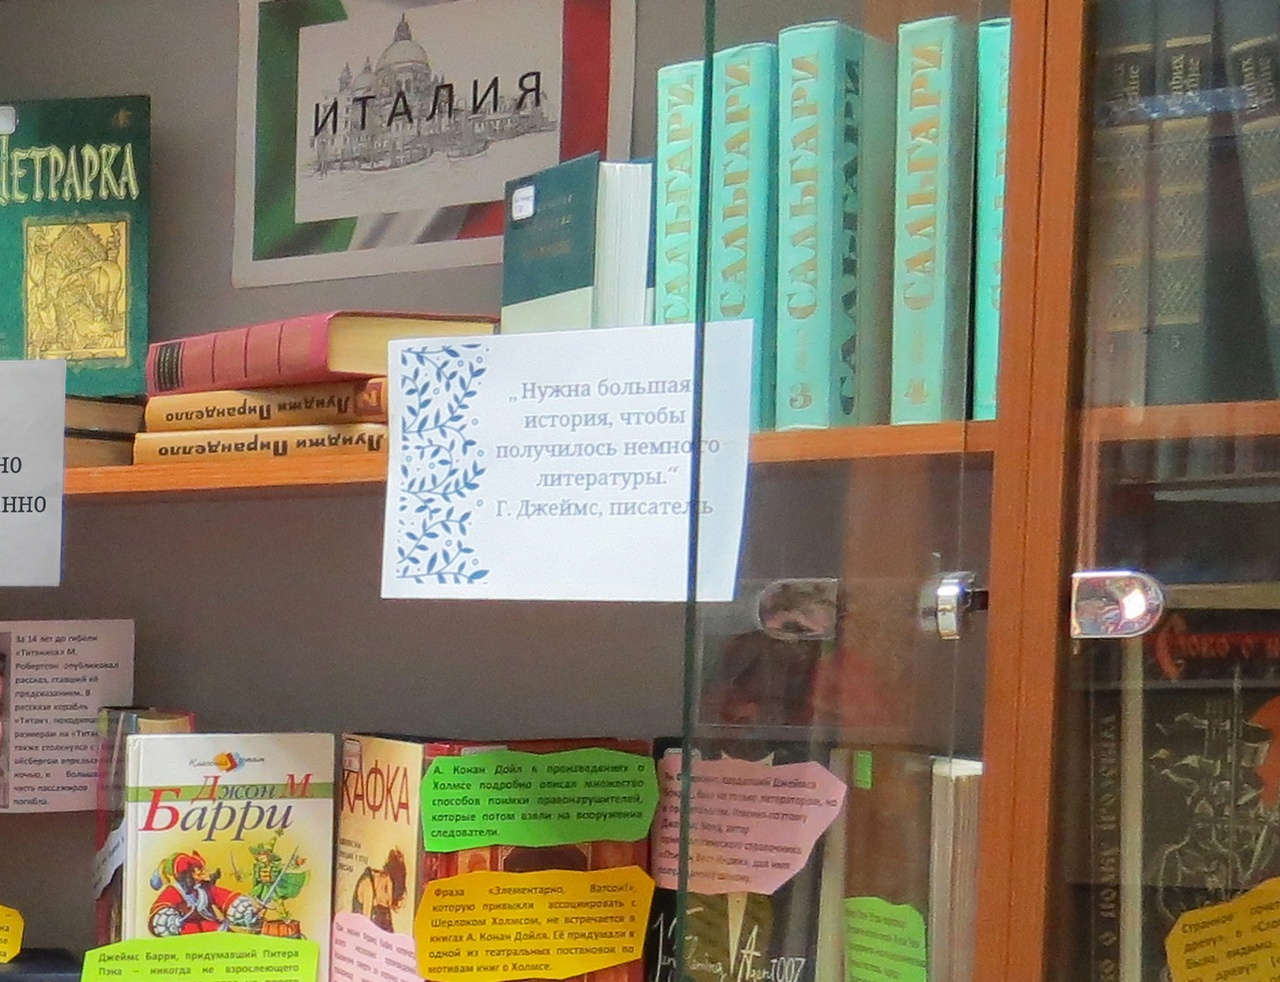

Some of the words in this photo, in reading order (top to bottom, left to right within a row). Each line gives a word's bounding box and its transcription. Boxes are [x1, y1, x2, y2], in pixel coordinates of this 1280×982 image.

[314, 71, 541, 136] ИТАЛИЯ
[720, 58, 752, 318] САЛЬГАРИ
[787, 51, 821, 320] САЛЬГАРИ
[903, 40, 943, 311] САЛЬГАРИ
[598, 378, 692, 397] большая
[524, 413, 613, 432] история,
[621, 408, 686, 425] чтобы
[158, 434, 288, 456] Пиранделло
[296, 434, 385, 451] Луиджи
[495, 442, 618, 463] получилось
[495, 501, 512, 517] Г.
[517, 500, 604, 519] Джеймс,
[191, 775, 276, 805] Джон
[341, 759, 411, 826] КАФКА
[138, 788, 297, 842] Барри
[263, 949, 299, 959] Питера
